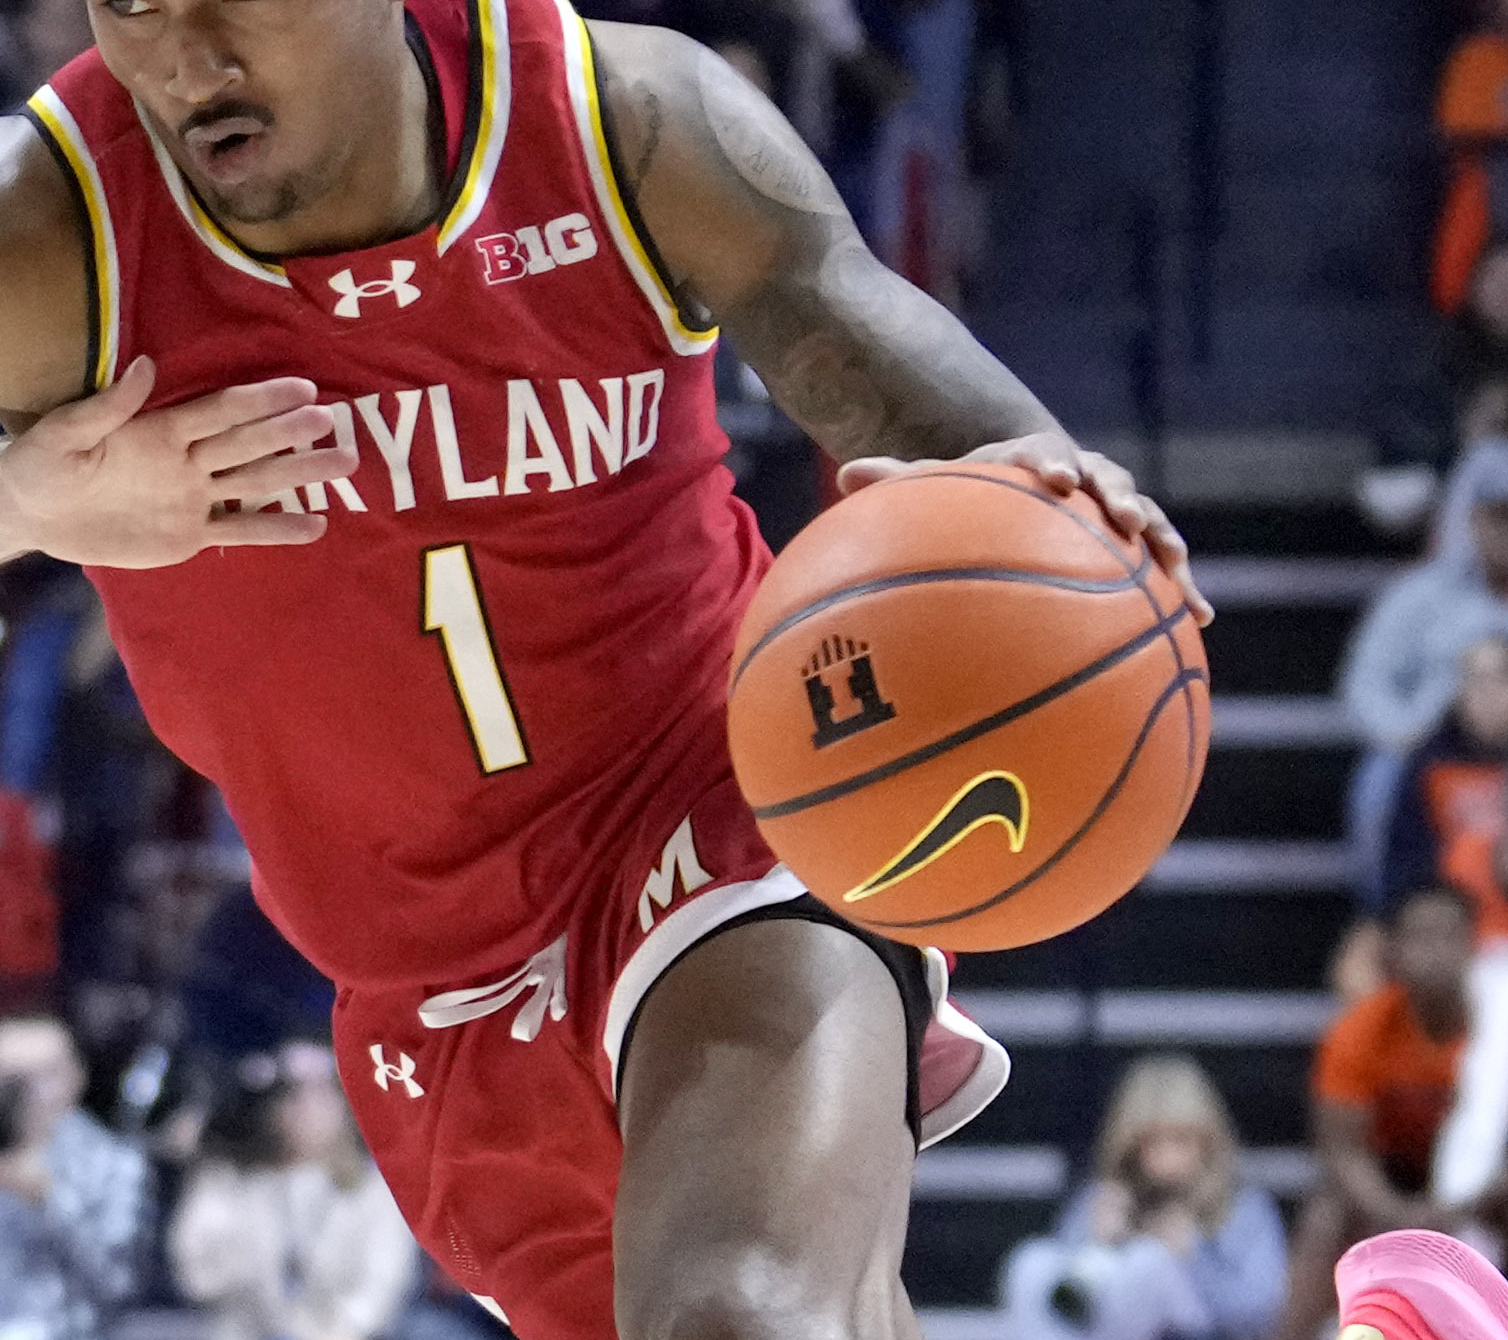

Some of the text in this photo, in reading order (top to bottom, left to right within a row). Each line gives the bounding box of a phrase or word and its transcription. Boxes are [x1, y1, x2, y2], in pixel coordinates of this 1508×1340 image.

[240, 368, 665, 513] RYLAND
[419, 542, 530, 776] 1
[638, 810, 716, 934] M
